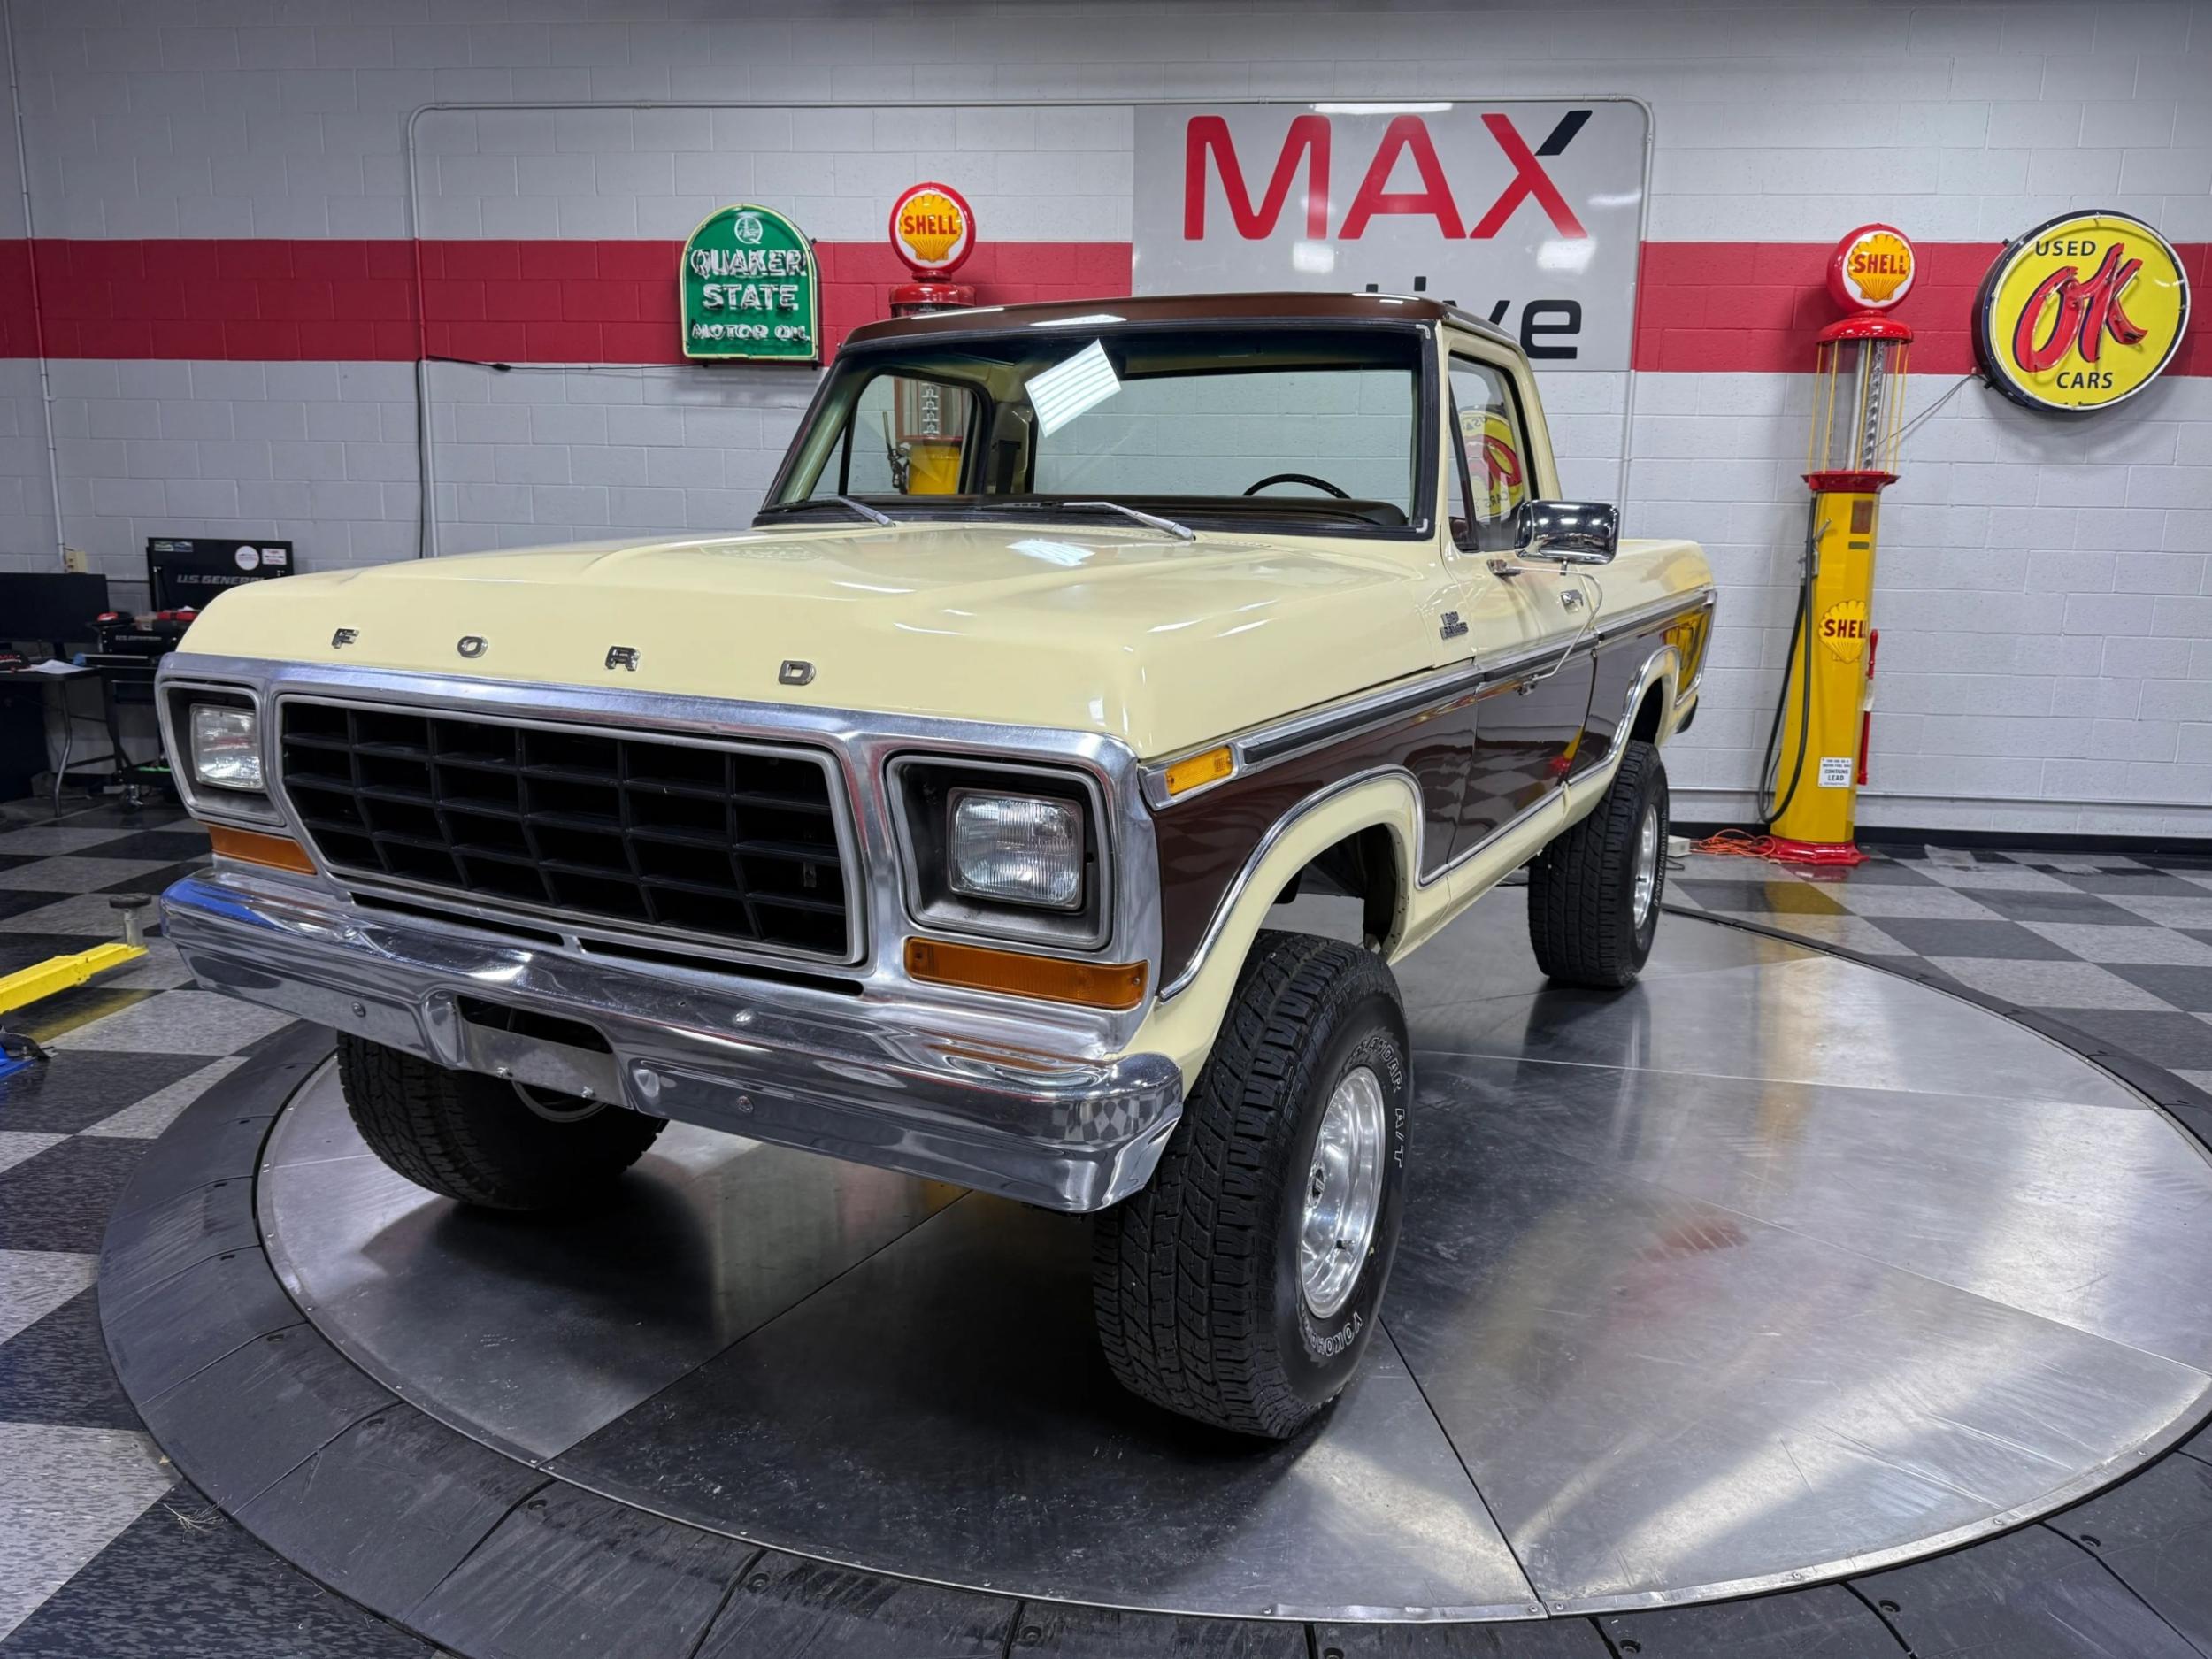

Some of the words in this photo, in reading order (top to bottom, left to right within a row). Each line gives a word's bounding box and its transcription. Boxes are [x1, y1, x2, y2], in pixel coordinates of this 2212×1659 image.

[1184, 110, 1593, 241] MAX
[903, 215, 958, 236] SHELL
[2035, 240, 2097, 257] USED
[690, 248, 807, 279] QUAKER
[1853, 254, 1908, 275] SHELL
[702, 283, 799, 311] STATE
[2013, 242, 2149, 373] OK
[692, 323, 769, 340] MOTOR
[774, 324, 811, 342] OIL
[2056, 372, 2113, 389] CARS
[201, 575, 265, 585] GENER
[330, 626, 816, 687] FORD
[1394, 1108, 1405, 1168] A/T
